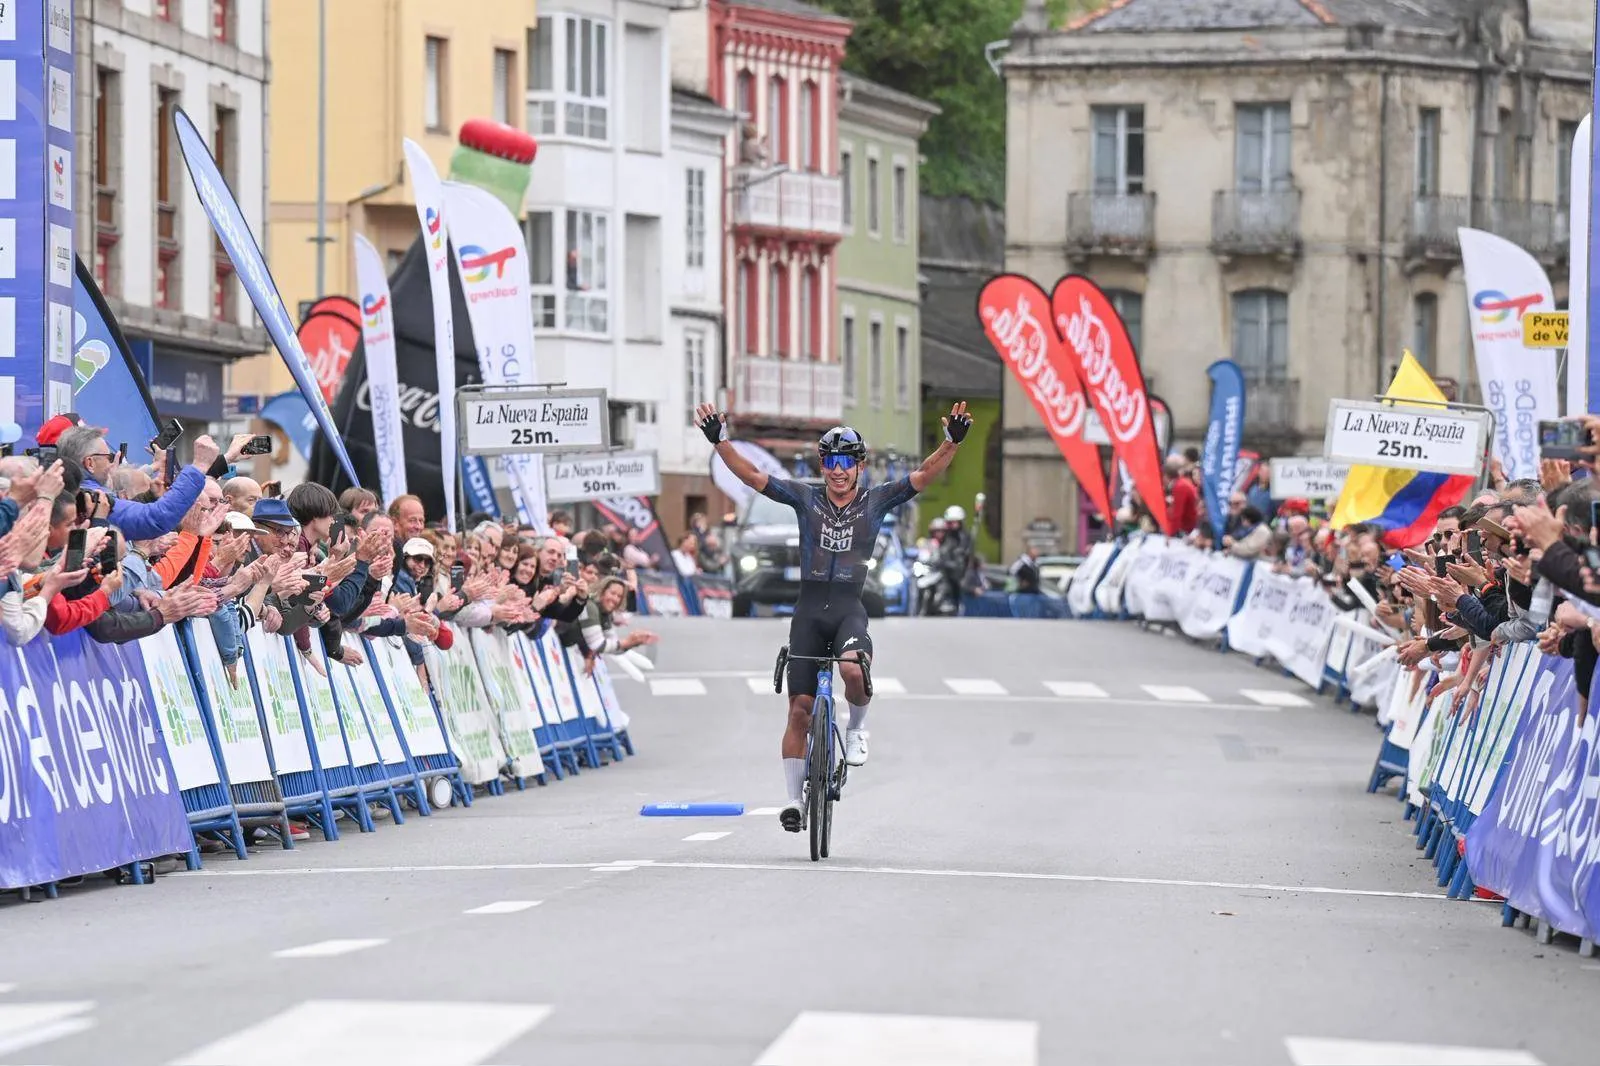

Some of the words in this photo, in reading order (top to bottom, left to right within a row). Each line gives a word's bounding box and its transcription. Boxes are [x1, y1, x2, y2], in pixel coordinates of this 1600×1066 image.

[1533, 315, 1569, 328] Parq
[1532, 330, 1550, 341] de
[1554, 329, 1569, 341] Ve
[475, 405, 494, 425] La
[497, 403, 537, 424] Nueva
[540, 402, 589, 426] España
[1342, 412, 1363, 432] La
[1366, 414, 1410, 436] Nueva
[1413, 417, 1465, 441] España
[511, 429, 559, 445] 25m.
[1377, 439, 1429, 460] 25m.
[554, 464, 569, 480] La
[571, 463, 603, 478] Nueva
[605, 460, 644, 477] España
[1281, 466, 1294, 479] La
[583, 481, 621, 494] 50m.
[822, 536, 850, 551] BAU
[48, 642, 169, 839] deporte
